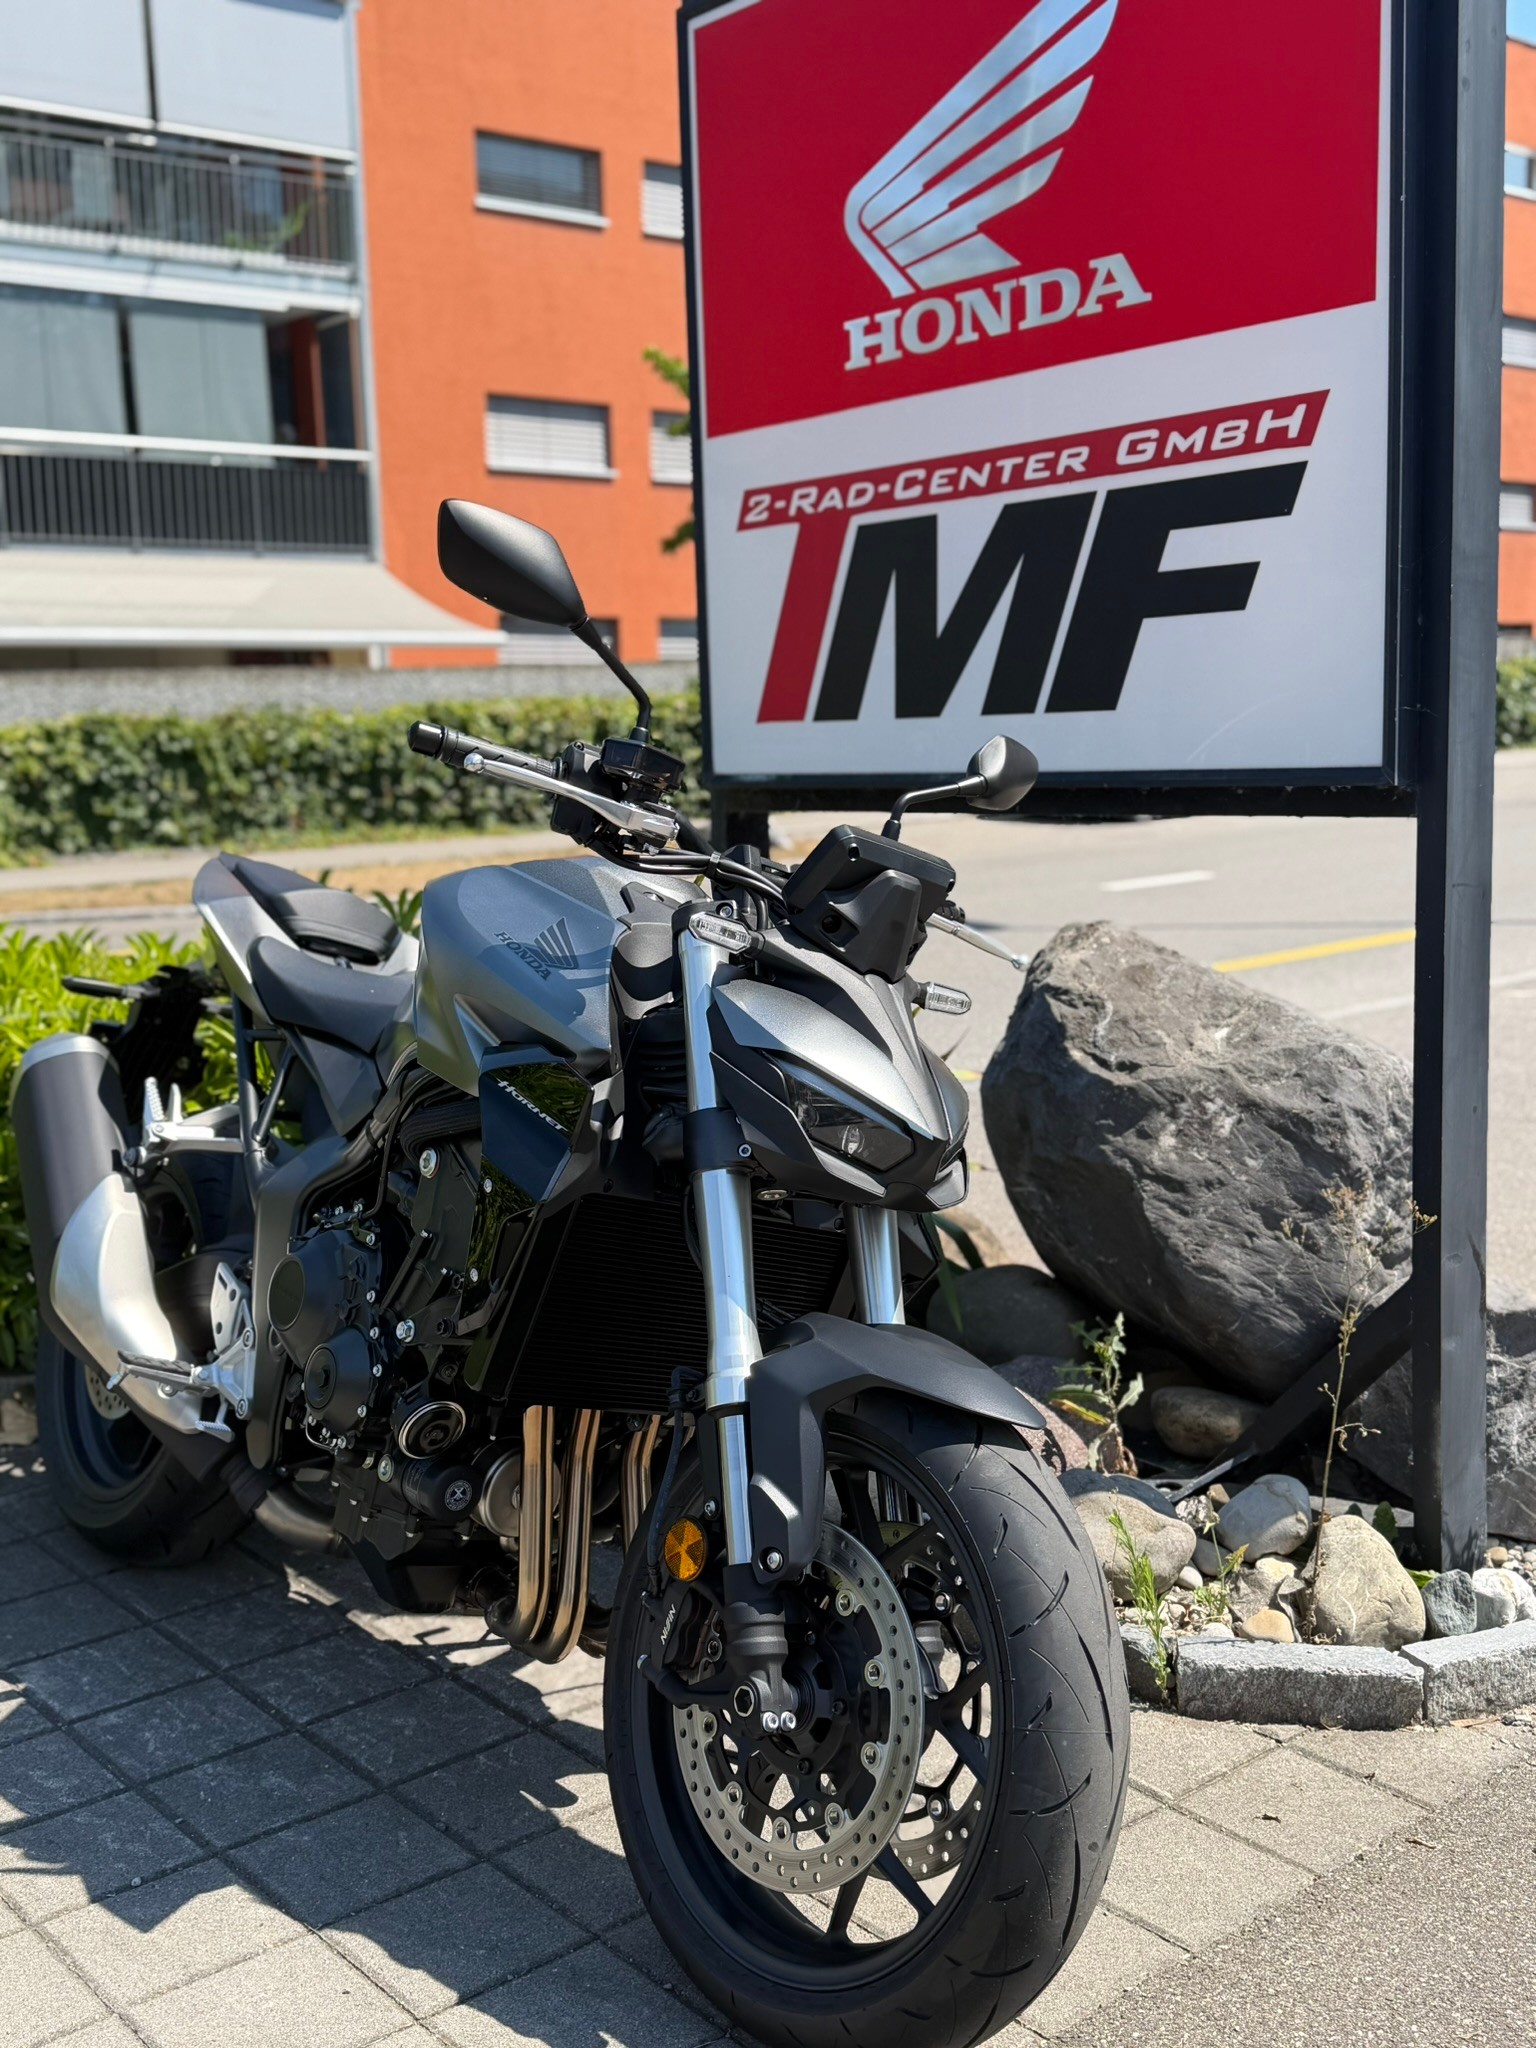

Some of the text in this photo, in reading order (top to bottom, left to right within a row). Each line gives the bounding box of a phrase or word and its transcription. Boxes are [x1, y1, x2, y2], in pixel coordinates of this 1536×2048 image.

[844, 253, 1151, 370] HONDA
[738, 460, 1308, 723] TMF
[494, 931, 551, 981] HONDA
[496, 1078, 568, 1132] HORNET
